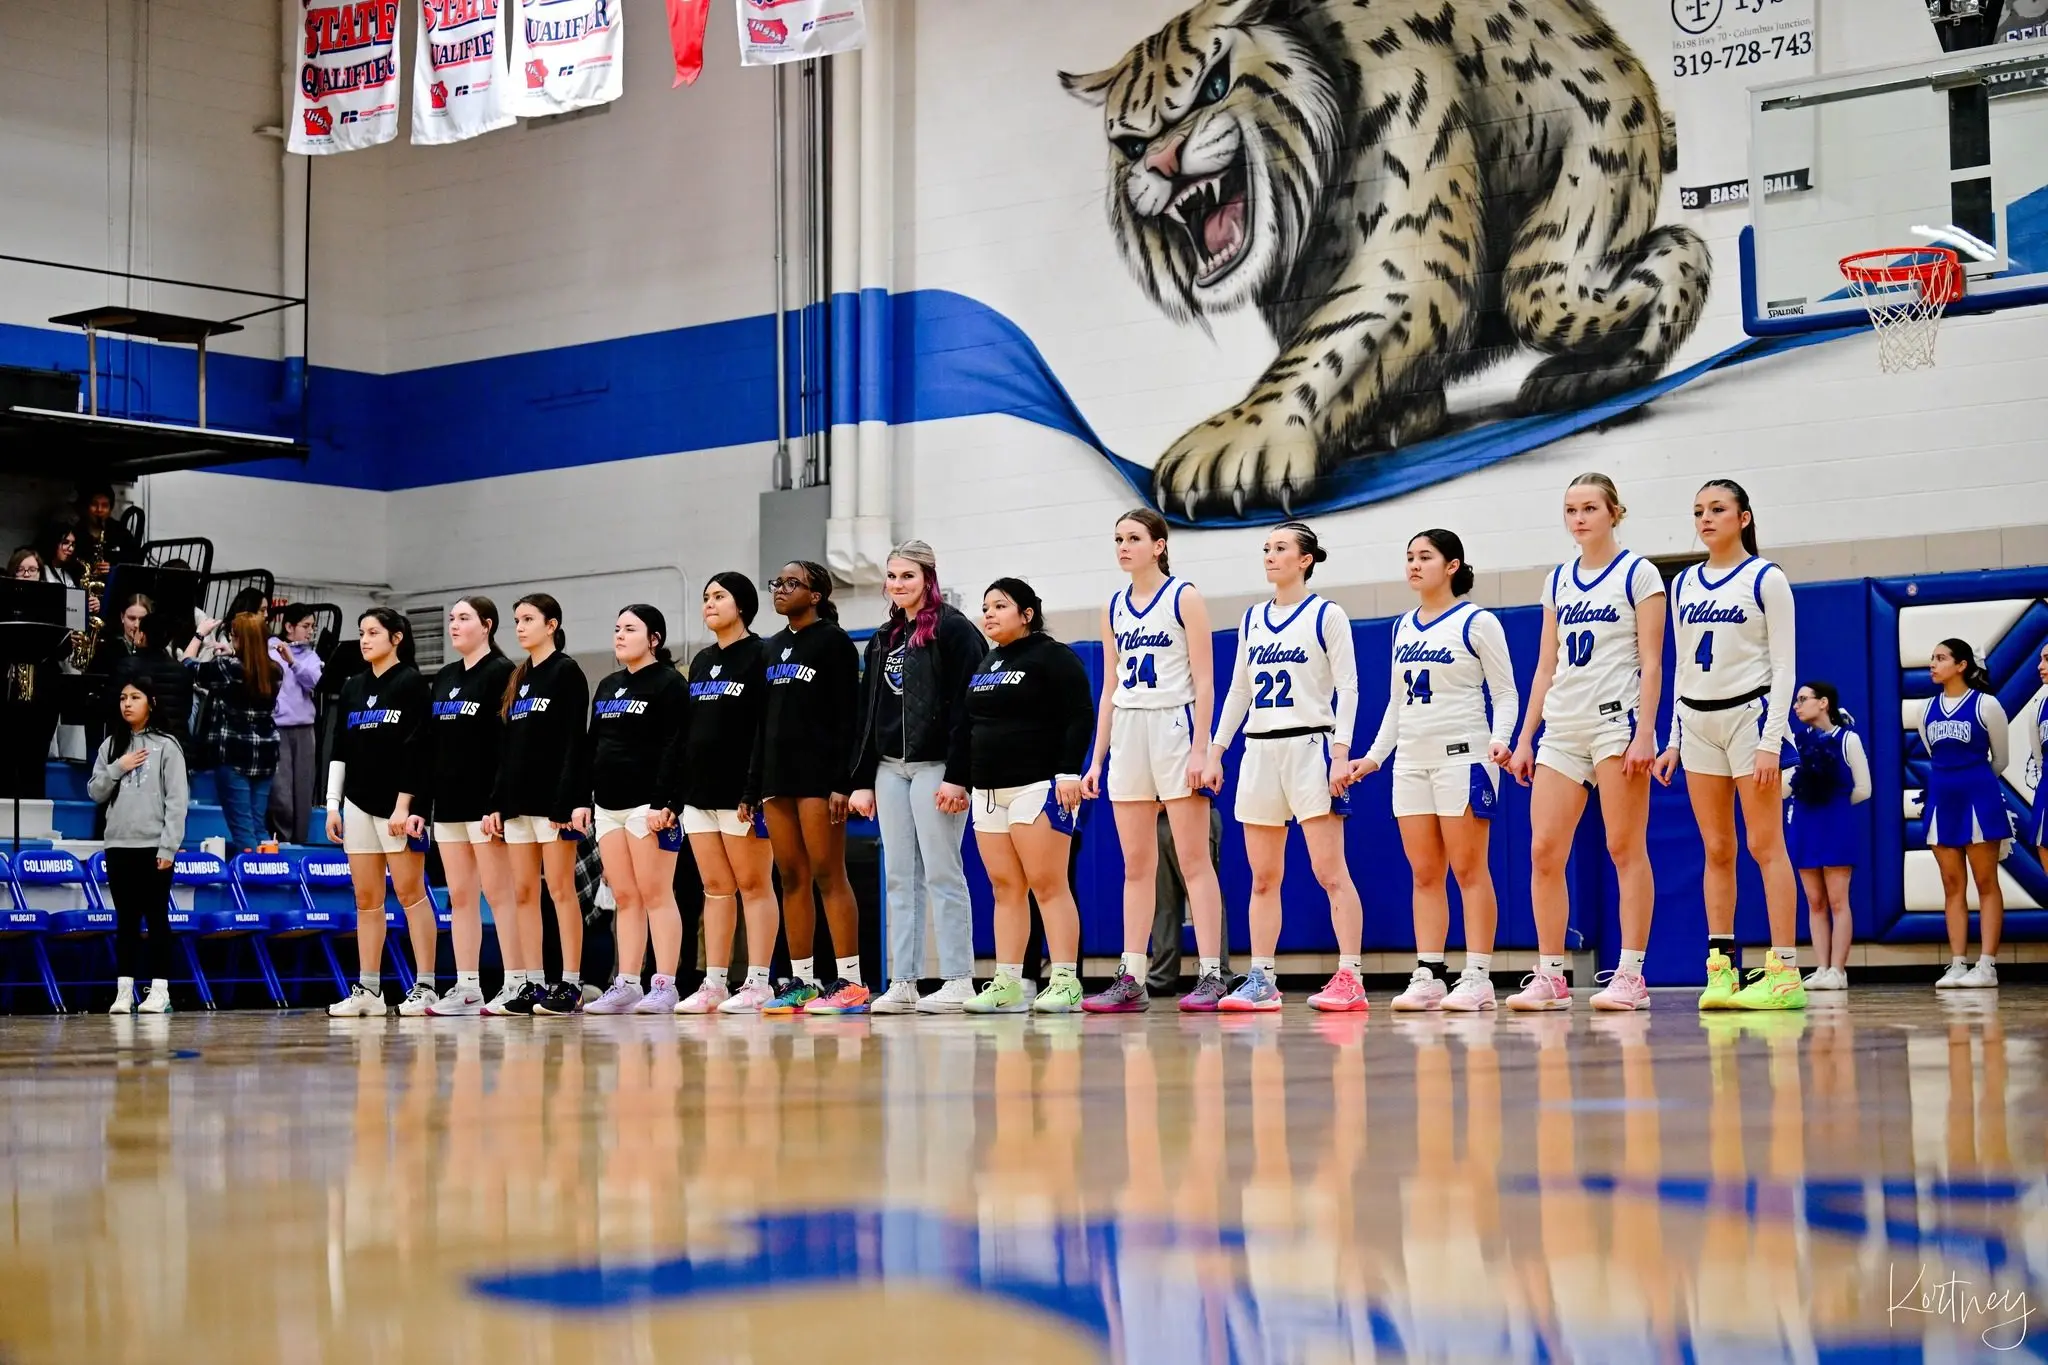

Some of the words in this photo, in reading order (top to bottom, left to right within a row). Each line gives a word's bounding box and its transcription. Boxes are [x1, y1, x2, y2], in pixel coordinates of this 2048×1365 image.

[304, 0, 398, 58] STATE
[1717, 32, 1727, 42] 70
[1733, 25, 1774, 38] Columbus
[1673, 31, 1814, 77] 319-728-743
[1682, 191, 1698, 206] 23
[1768, 305, 1804, 319] SPALDING
[1557, 601, 1620, 626] Wildcats
[1680, 600, 1747, 626] Wildcats
[1247, 642, 1309, 666] Wildcats
[1395, 641, 1455, 664] Wildcats
[1566, 630, 1595, 666] 10
[1695, 631, 1714, 672] 4
[1123, 653, 1157, 690] 34
[1255, 670, 1294, 709] 22
[1404, 669, 1433, 705] 14
[1927, 720, 1972, 746] WILDCATS
[23, 859, 74, 873] COLUMBUS
[243, 861, 290, 876] COLUMBUS
[10, 914, 36, 922] WILDCATS
[87, 914, 113, 922] WILDCATS
[235, 914, 260, 922] WILDCATS
[306, 913, 329, 921] WILDCATS
